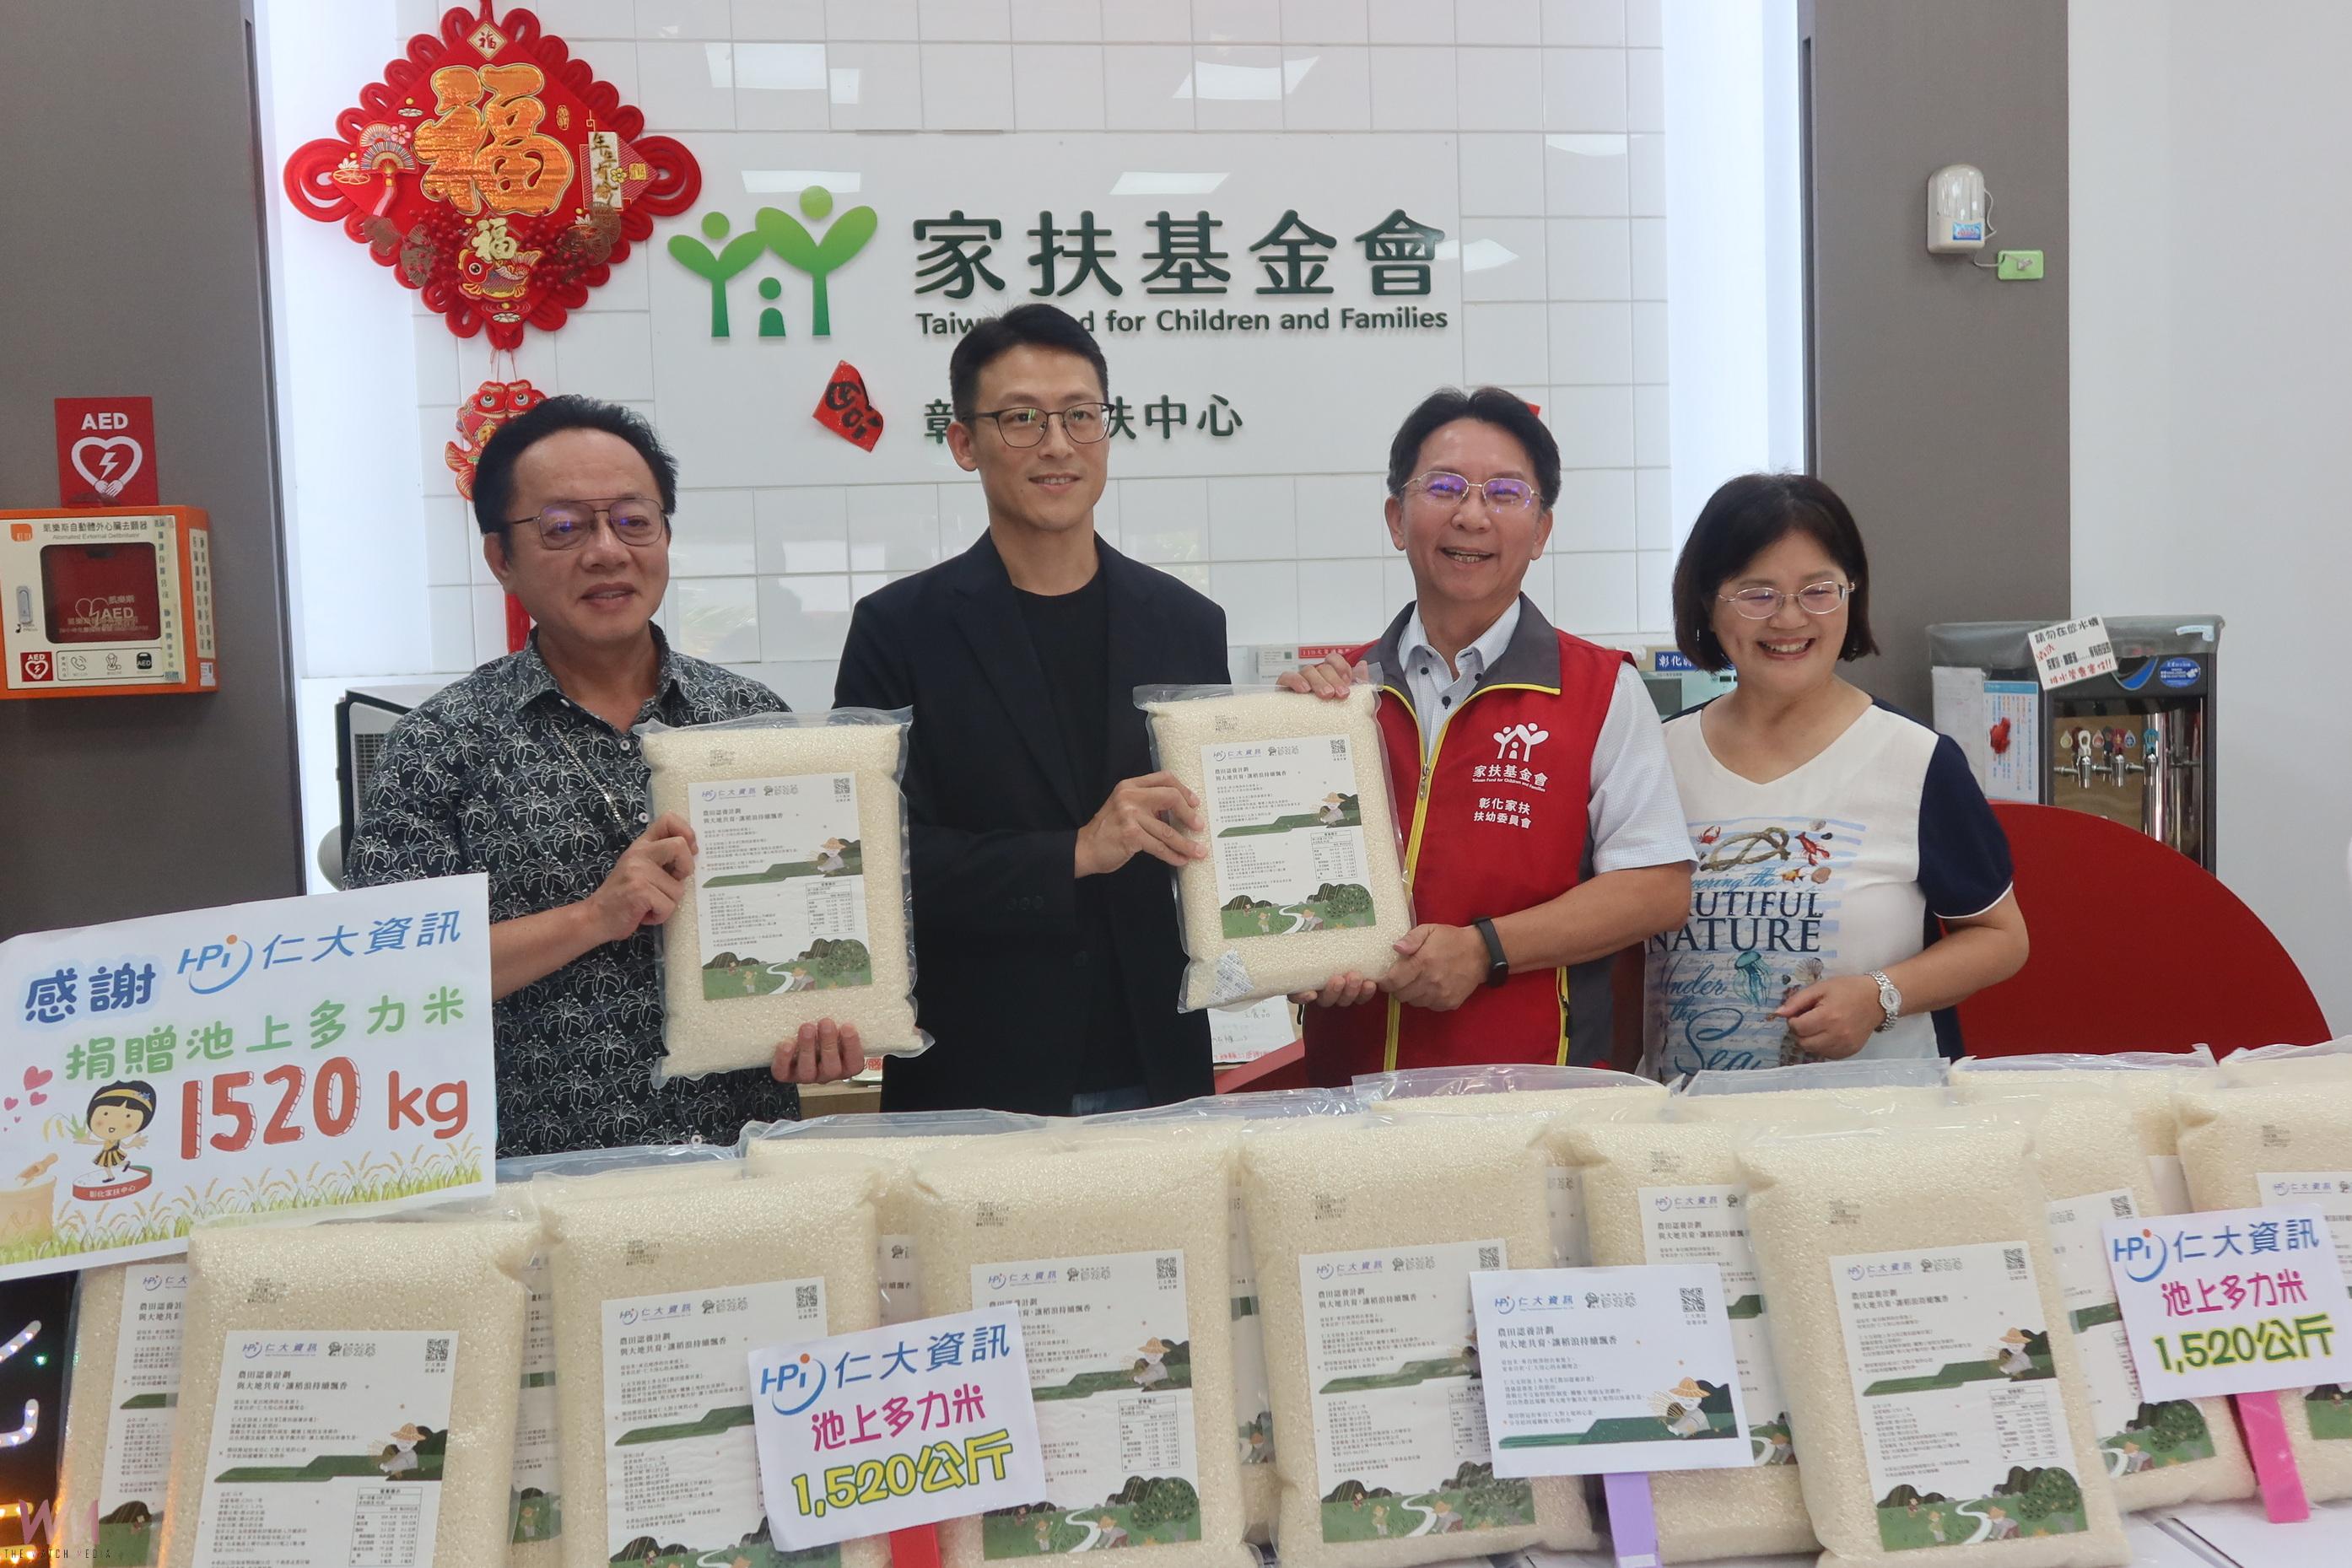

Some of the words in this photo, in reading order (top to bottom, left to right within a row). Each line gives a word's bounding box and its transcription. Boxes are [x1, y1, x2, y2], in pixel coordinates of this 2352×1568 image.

[411, 62, 575, 217] 福
[472, 216, 518, 263] 福
[913, 208, 1445, 299] 家扶基金會
[1106, 309, 1146, 332] for
[1156, 309, 1270, 332] Children
[1280, 309, 1329, 331] and
[1340, 307, 1448, 330] Families
[81, 413, 128, 430] AED
[925, 396, 1243, 444] 彰扶中心
[101, 607, 134, 619] AED
[1473, 764, 1548, 786] 家扶基金會
[1474, 811, 1532, 829] 扶幼委員會
[1479, 797, 1530, 816] 彰化家扶
[177, 935, 246, 985] HPi
[263, 910, 461, 970] 仁大資訊
[24, 962, 156, 1024] 感謝
[66, 985, 464, 1080] 捐贈池上多力米
[181, 1056, 362, 1160] 1520
[387, 1070, 468, 1139] kg
[2114, 1229, 2160, 1274] HPi
[2173, 1218, 2320, 1263] 仁大資訊
[2161, 1269, 2308, 1317] 池上多力米
[761, 1354, 817, 1404] HPi
[835, 1324, 1011, 1389] 仁大資訊
[2153, 1314, 2335, 1374] 1,520公斤
[813, 1382, 986, 1451] 池上多力米
[791, 1431, 1013, 1517] 1,520公斤
